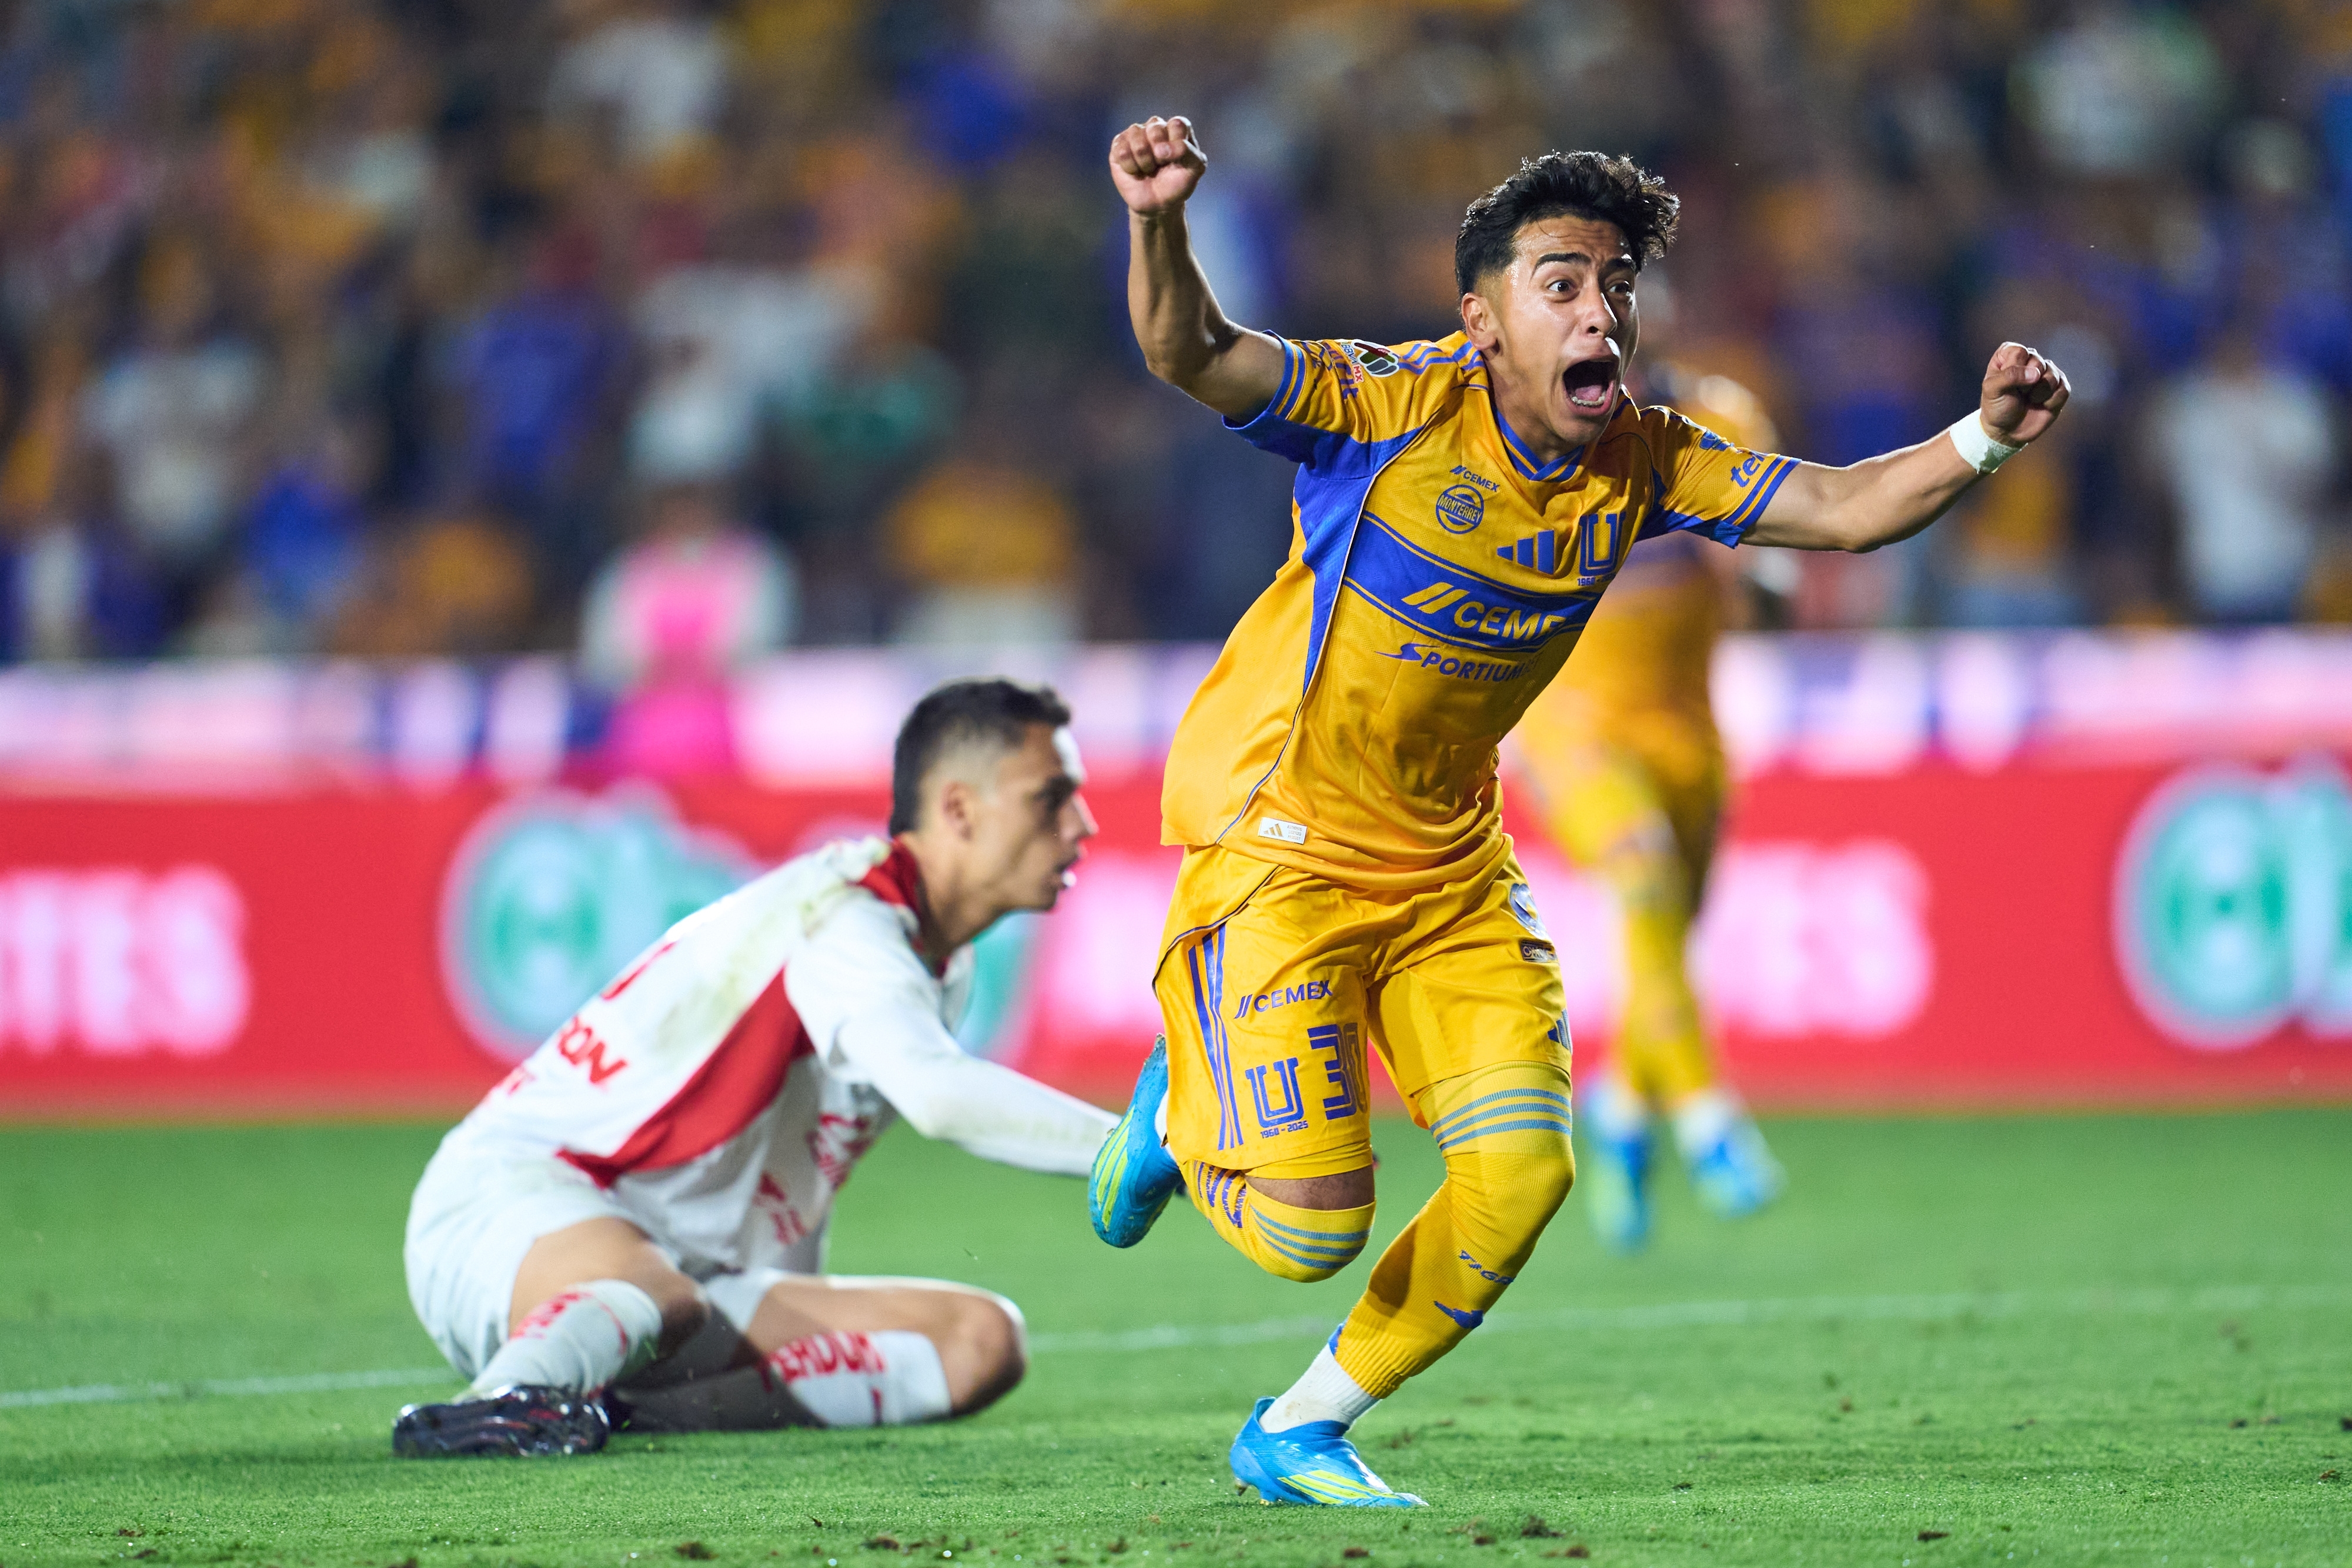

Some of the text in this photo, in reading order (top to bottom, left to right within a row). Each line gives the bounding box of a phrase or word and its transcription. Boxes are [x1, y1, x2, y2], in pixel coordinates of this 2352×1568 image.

[1341, 345, 1363, 382] BBVA MX
[1463, 470, 1500, 492] CEMEX
[1437, 494, 1482, 523] MONTERREY
[1254, 979, 1333, 1012] CEMEX
[1245, 1057, 1305, 1128] U
[1260, 1127, 1279, 1139] 1960
[1287, 1120, 1309, 1132] 2025
